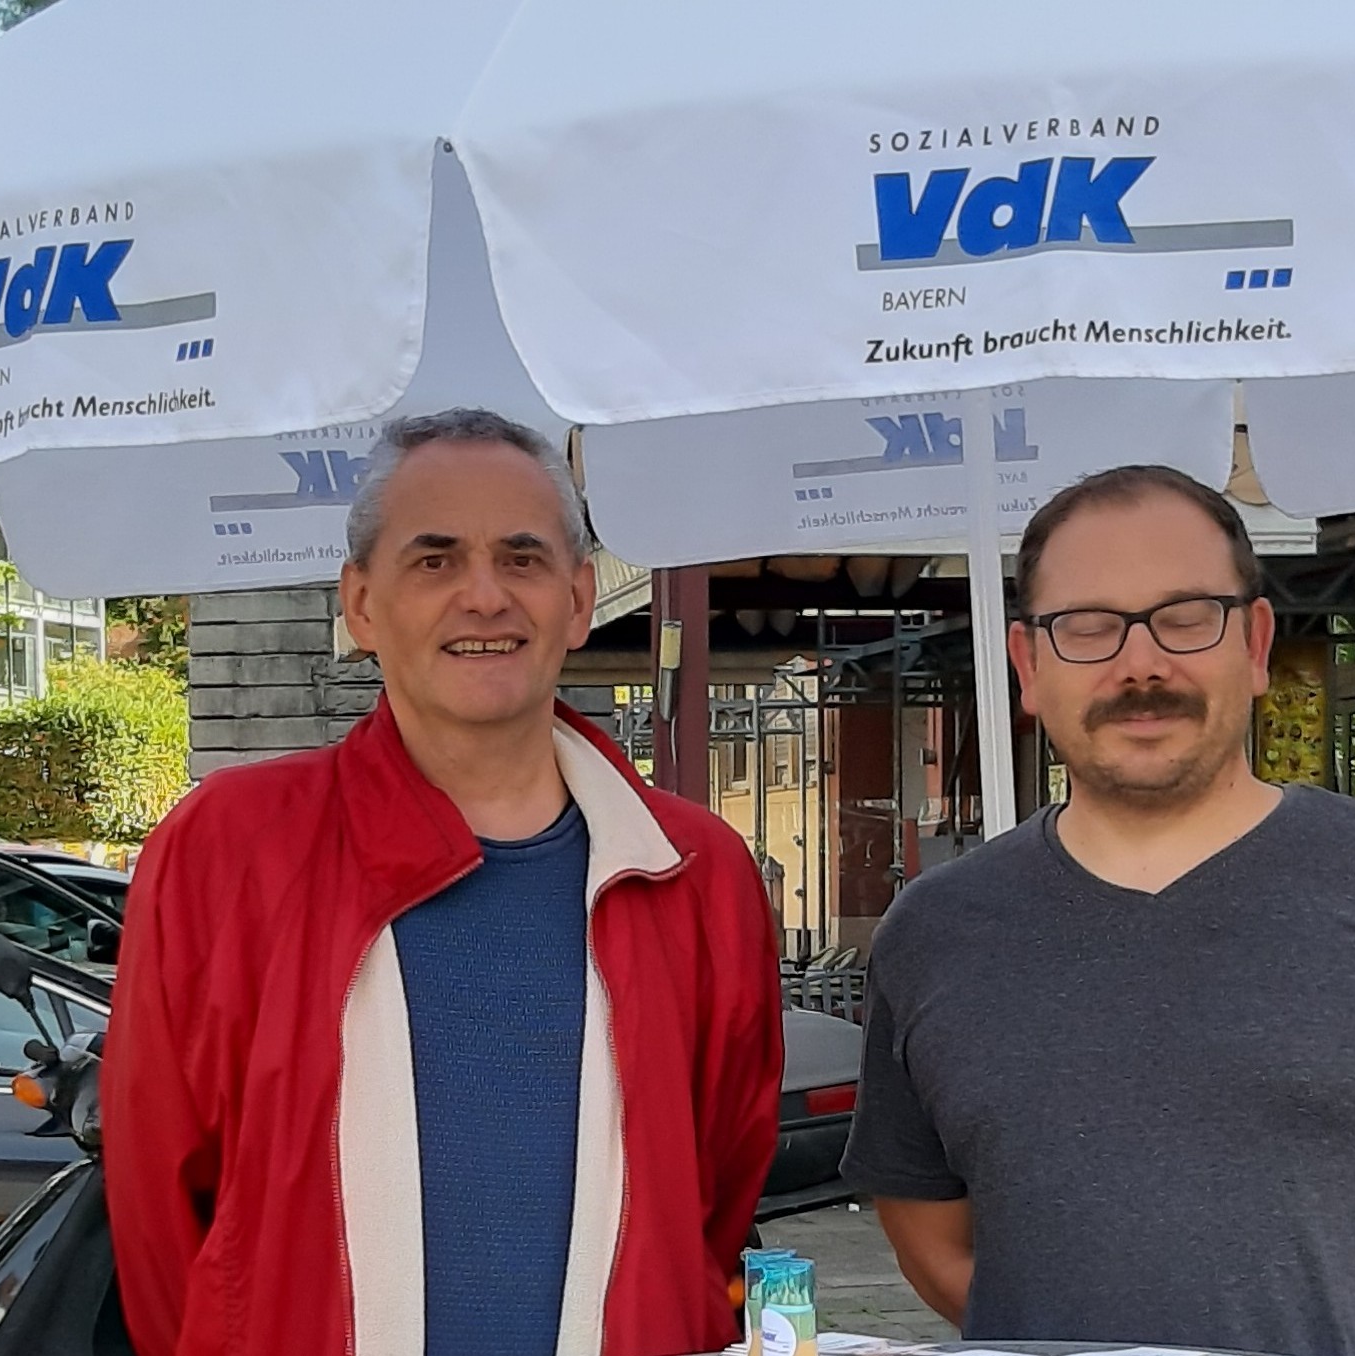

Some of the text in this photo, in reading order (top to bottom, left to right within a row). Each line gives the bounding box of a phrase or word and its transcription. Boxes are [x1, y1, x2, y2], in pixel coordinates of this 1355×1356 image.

[868, 115, 1161, 154] SOZIALVERBAND
[873, 155, 1157, 261] VdK
[881, 286, 968, 312] BAYERN
[864, 318, 1293, 364] Zukunft braucht Menschlichkeit.
[71, 386, 217, 418] Menschlichkeit.
